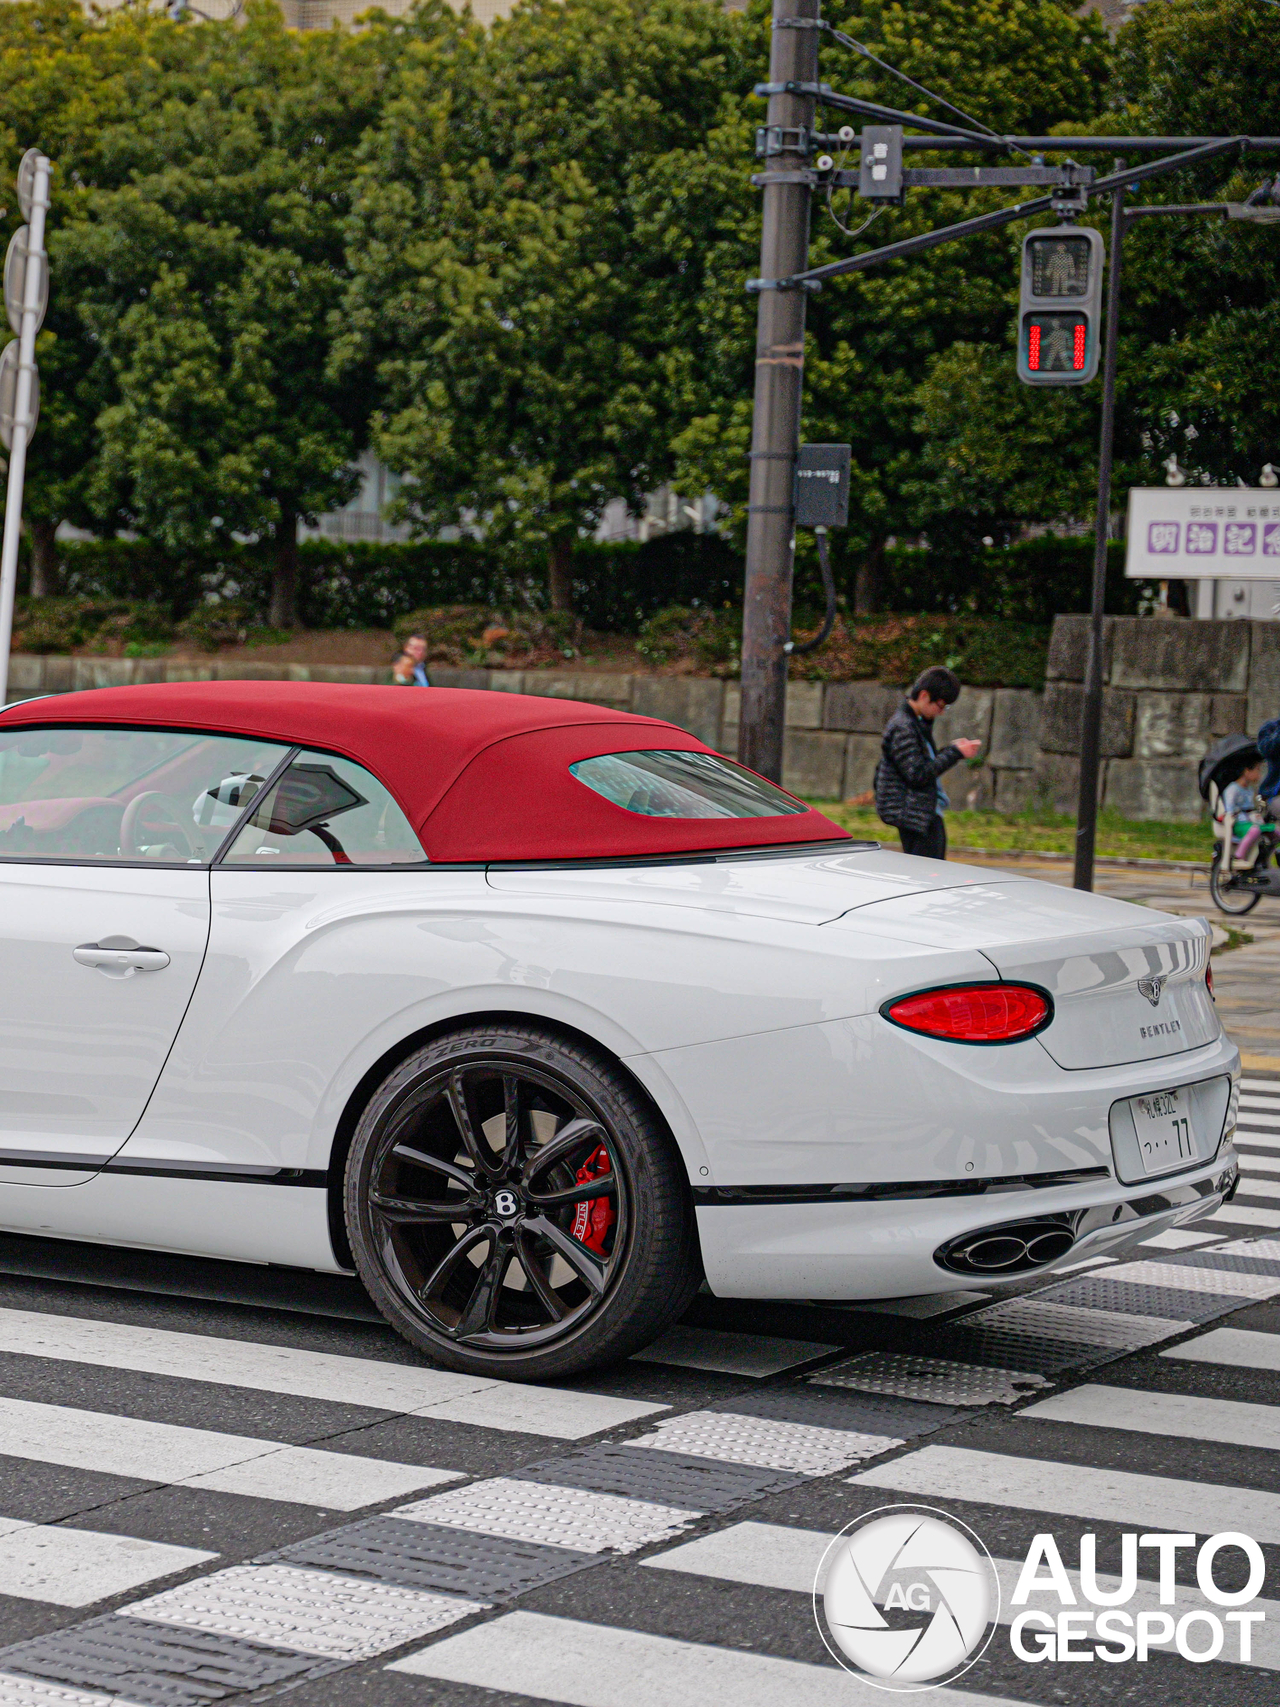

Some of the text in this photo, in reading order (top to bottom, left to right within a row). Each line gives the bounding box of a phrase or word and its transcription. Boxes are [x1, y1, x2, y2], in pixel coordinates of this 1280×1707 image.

[1139, 1019, 1181, 1039] BENTLEY
[417, 1037, 498, 1069] P ZERO
[495, 1192, 517, 1216] B
[575, 1203, 587, 1241] NTLEY
